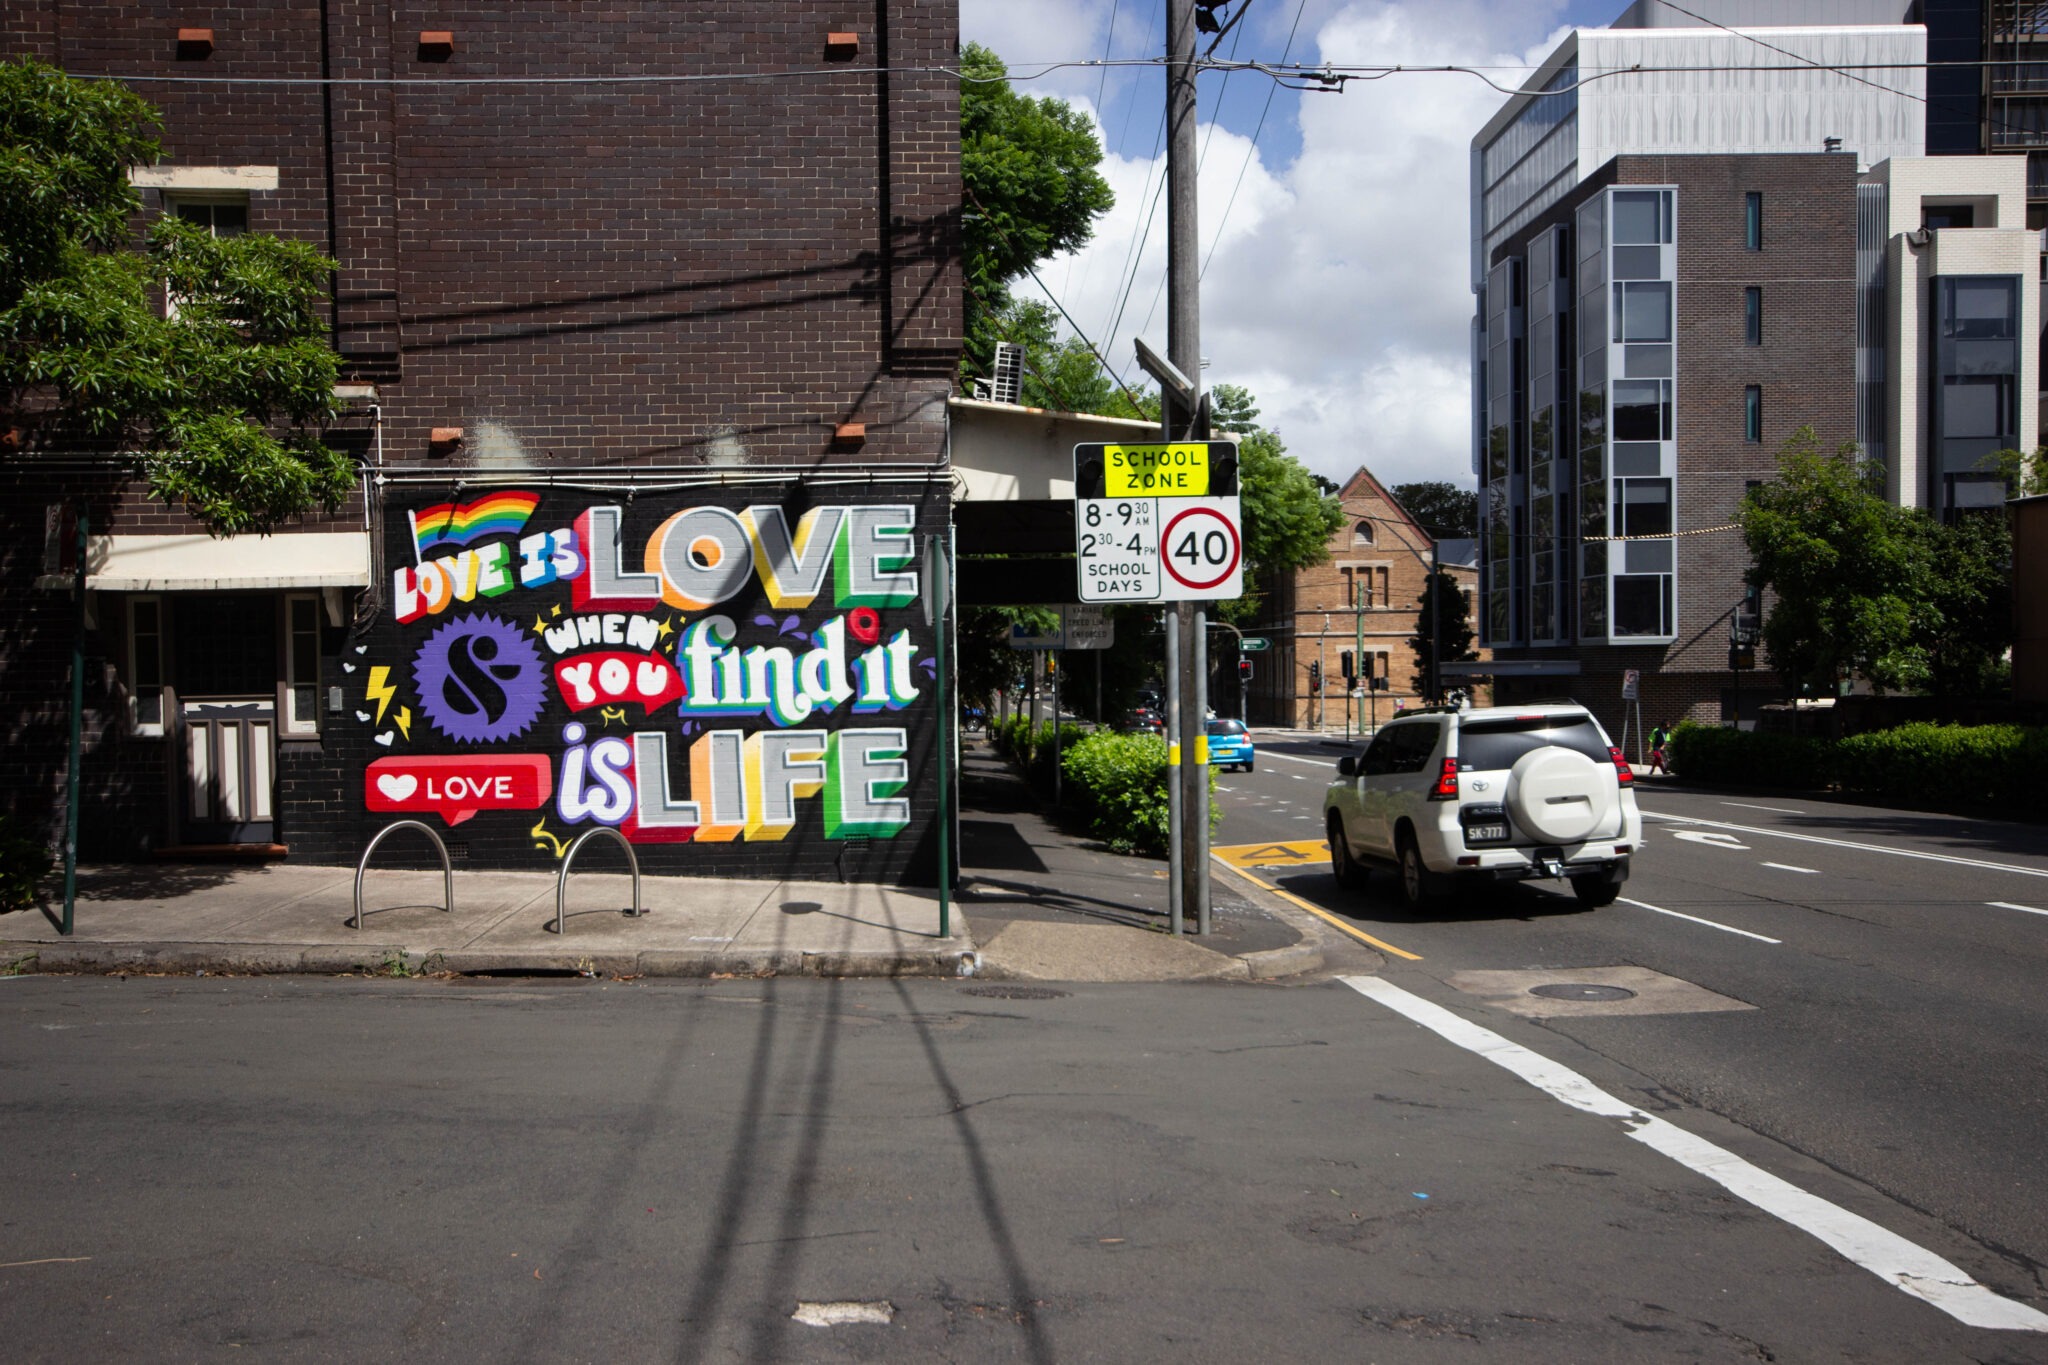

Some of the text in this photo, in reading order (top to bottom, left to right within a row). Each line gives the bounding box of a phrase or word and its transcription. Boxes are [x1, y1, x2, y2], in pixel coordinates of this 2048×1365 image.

[1112, 451, 1201, 467] SCHOOL
[1127, 473, 1188, 488] ZONE
[394, 504, 919, 625] LOVE IS LOVE
[1174, 530, 1228, 565] 40
[1088, 563, 1151, 577] SCHOOL
[1097, 580, 1143, 593] DAYS
[1072, 606, 1103, 614] VARIABL
[543, 614, 661, 655] WHEN
[676, 614, 854, 727] find
[851, 606, 920, 715] it
[560, 657, 668, 703] YOU
[427, 775, 514, 800] LOVE
[557, 721, 911, 843] is LIFE
